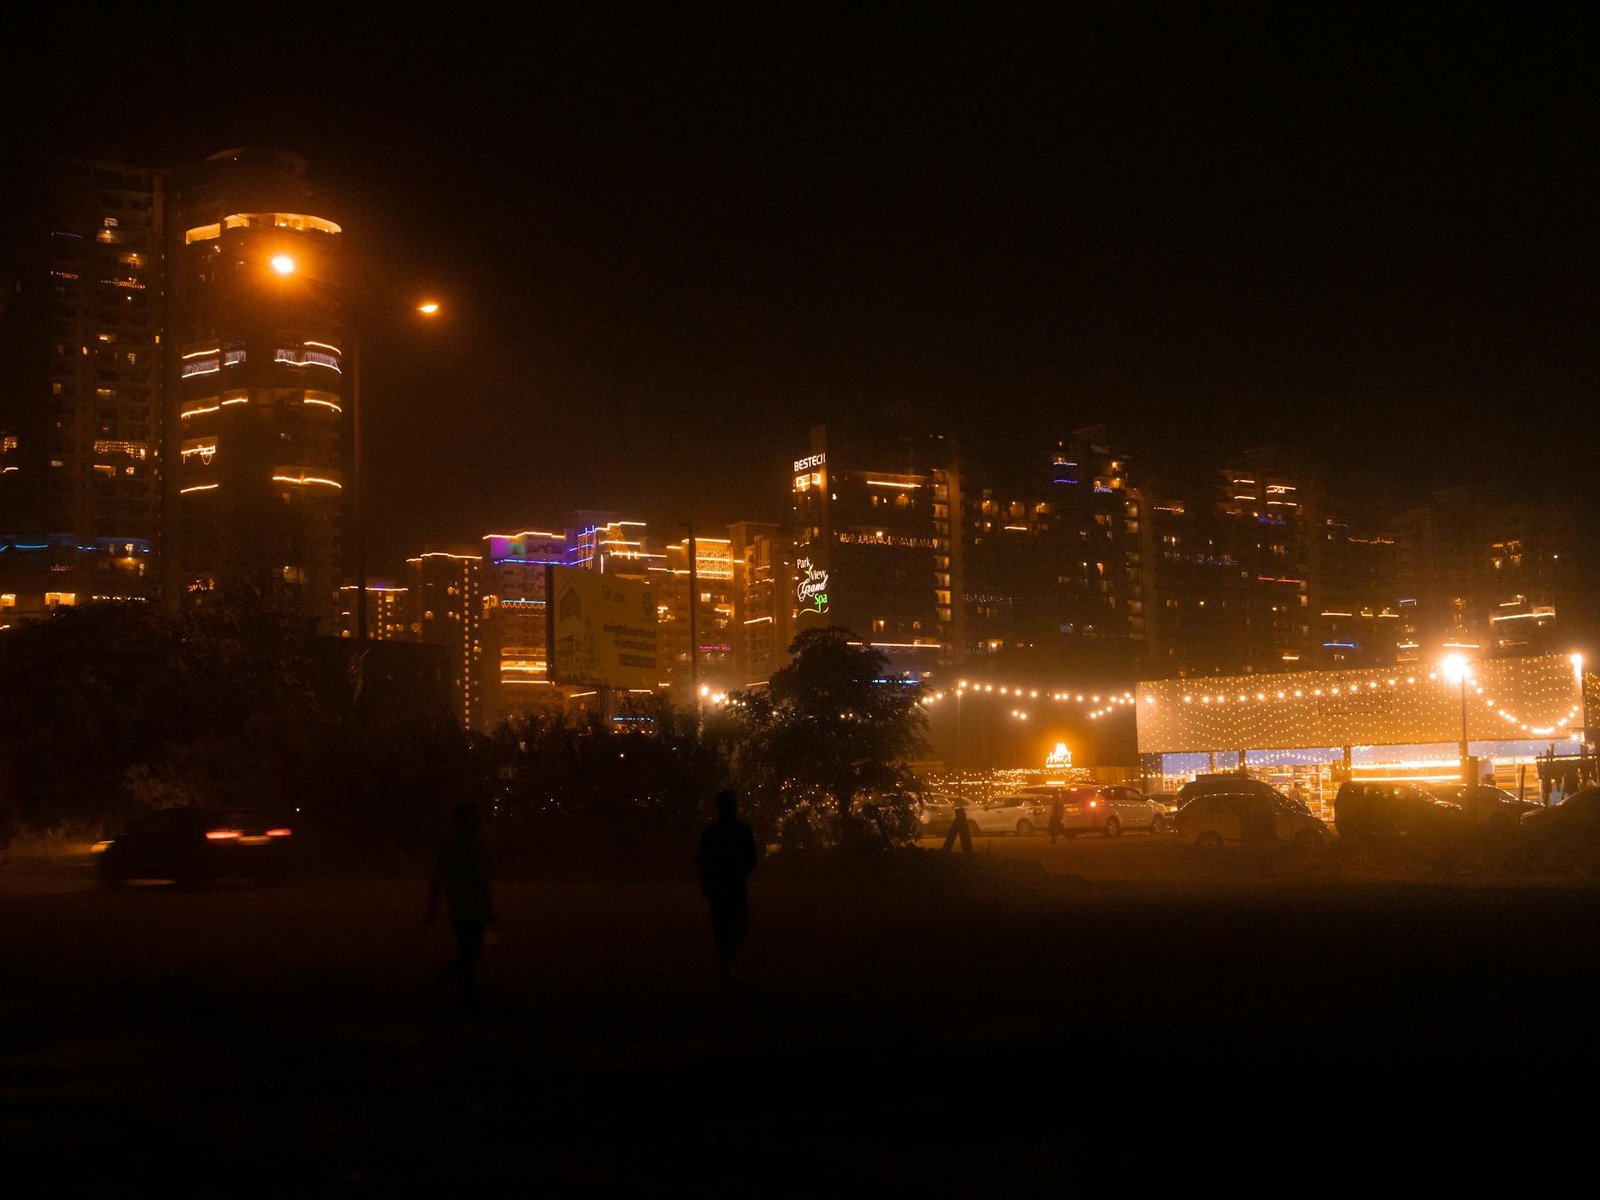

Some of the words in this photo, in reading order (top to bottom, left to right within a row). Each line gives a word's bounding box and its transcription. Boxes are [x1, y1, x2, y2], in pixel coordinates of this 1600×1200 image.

[797, 556, 810, 569] Park
[797, 574, 829, 602] Grand
[814, 593, 828, 613] Spa
